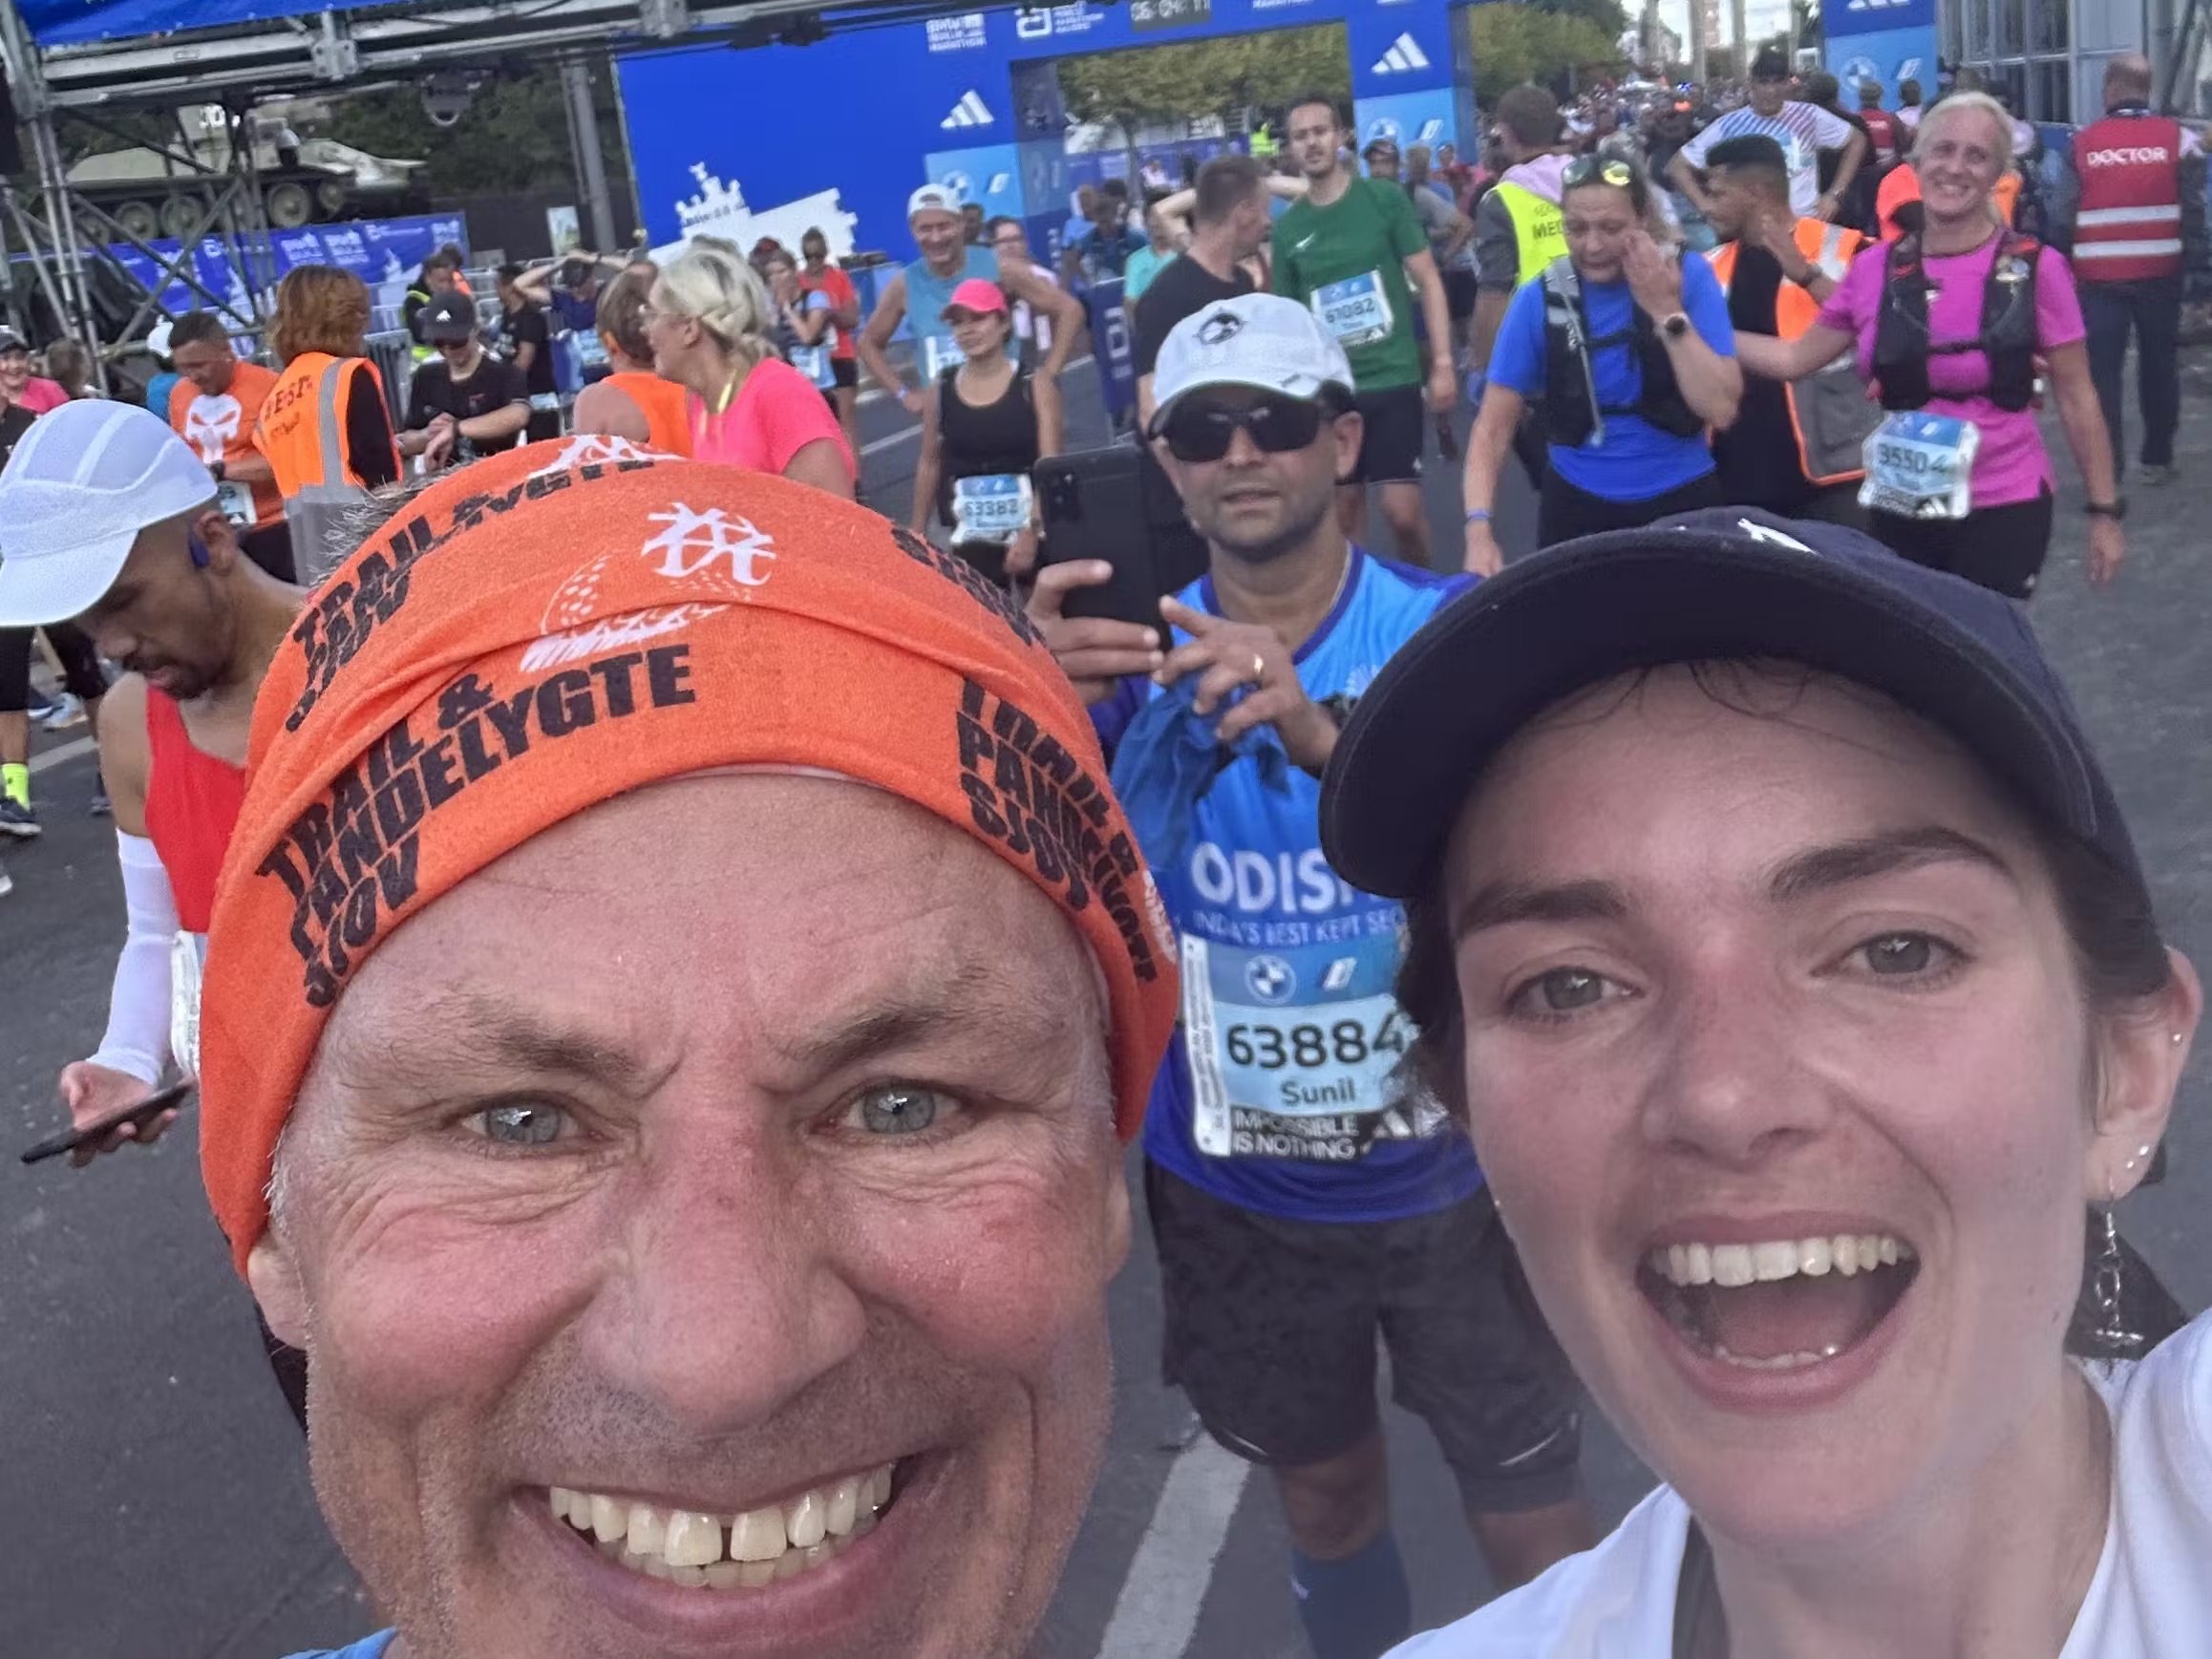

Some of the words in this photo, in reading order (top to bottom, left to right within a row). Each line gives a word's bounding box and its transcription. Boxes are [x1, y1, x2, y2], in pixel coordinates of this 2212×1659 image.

[2087, 146, 2168, 167] DOCTOR
[255, 718, 423, 904] TRAIL
[437, 674, 493, 731] &
[1226, 1010, 1404, 1070] 63884
[1280, 1076, 1355, 1106] Sunil
[1235, 1109, 1359, 1138] IMOSSIBLE
[1255, 1133, 1356, 1160] NOTHING
